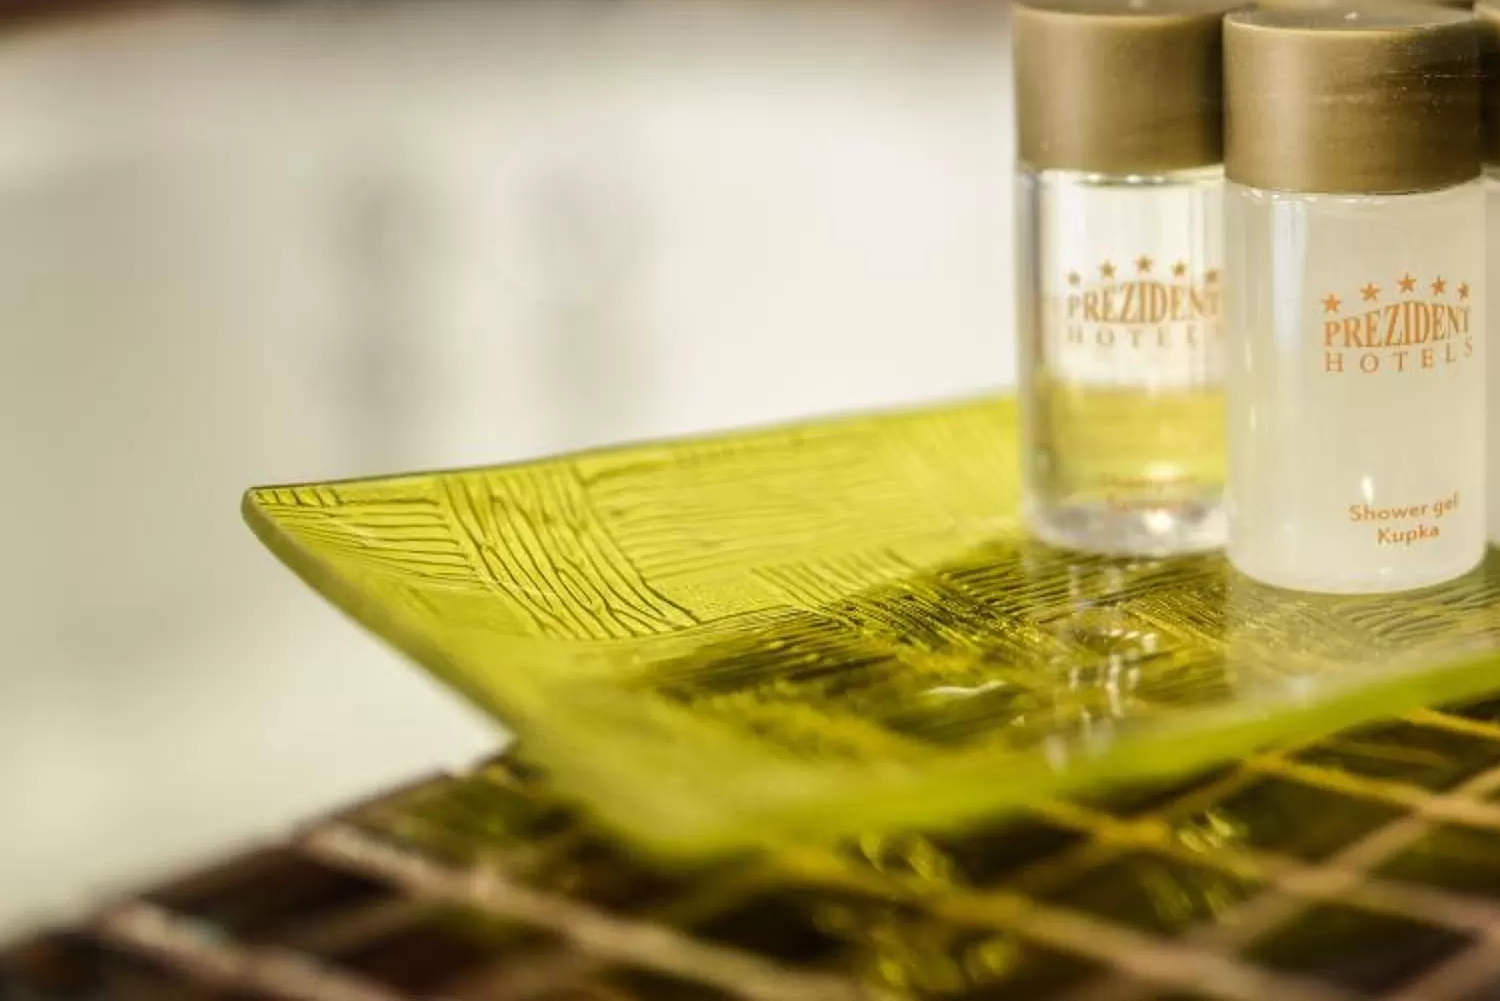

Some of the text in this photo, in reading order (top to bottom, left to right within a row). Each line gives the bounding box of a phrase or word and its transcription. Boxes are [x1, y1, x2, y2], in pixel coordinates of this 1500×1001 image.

[1067, 280, 1223, 324] PREZIDENT
[1324, 300, 1471, 347] PREZIDENT
[1325, 336, 1473, 373] HOTELS
[1349, 490, 1458, 522] Shower gel
[1378, 524, 1439, 546] Kupka
